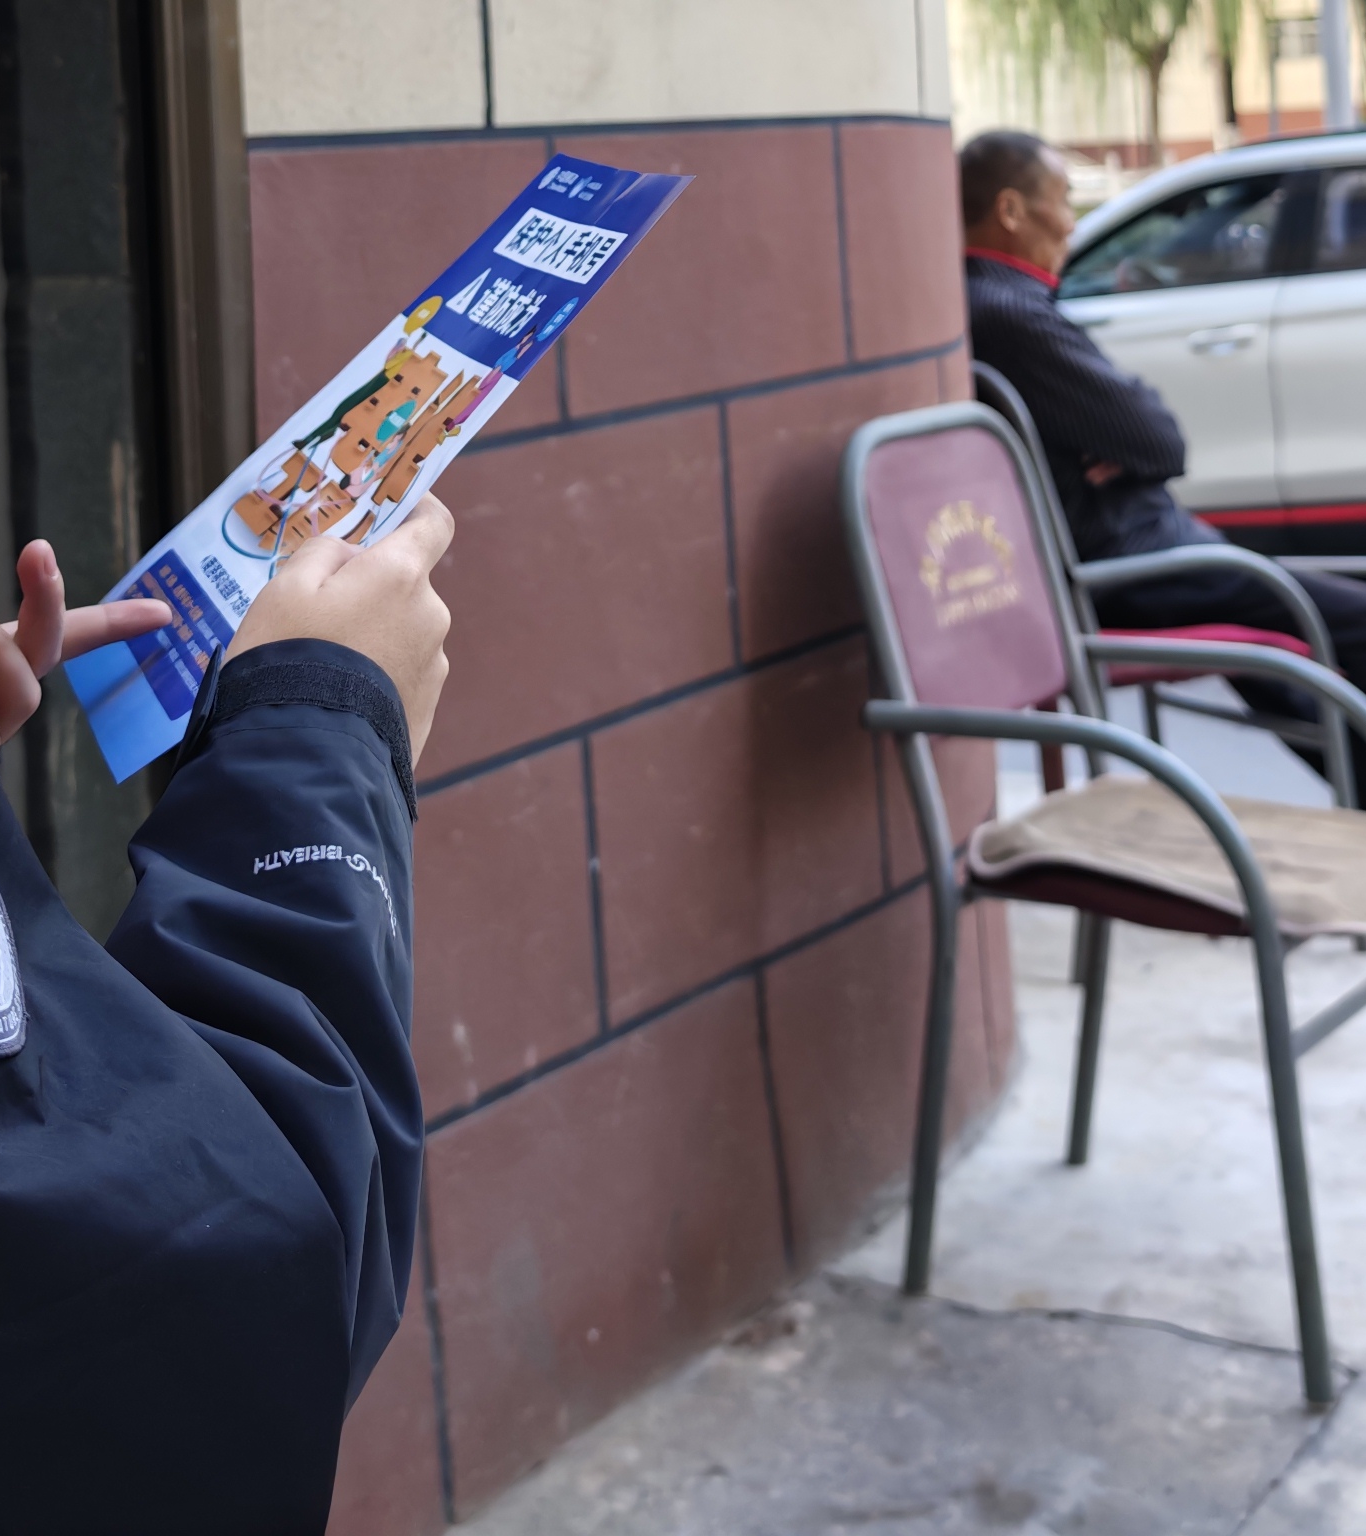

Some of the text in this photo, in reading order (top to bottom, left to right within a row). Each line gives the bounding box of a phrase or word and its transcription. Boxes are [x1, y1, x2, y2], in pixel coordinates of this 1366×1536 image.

[505, 214, 617, 276] 保护个人手机号
[468, 277, 547, 338] 谨防成为
[253, 845, 343, 875] BREATH
